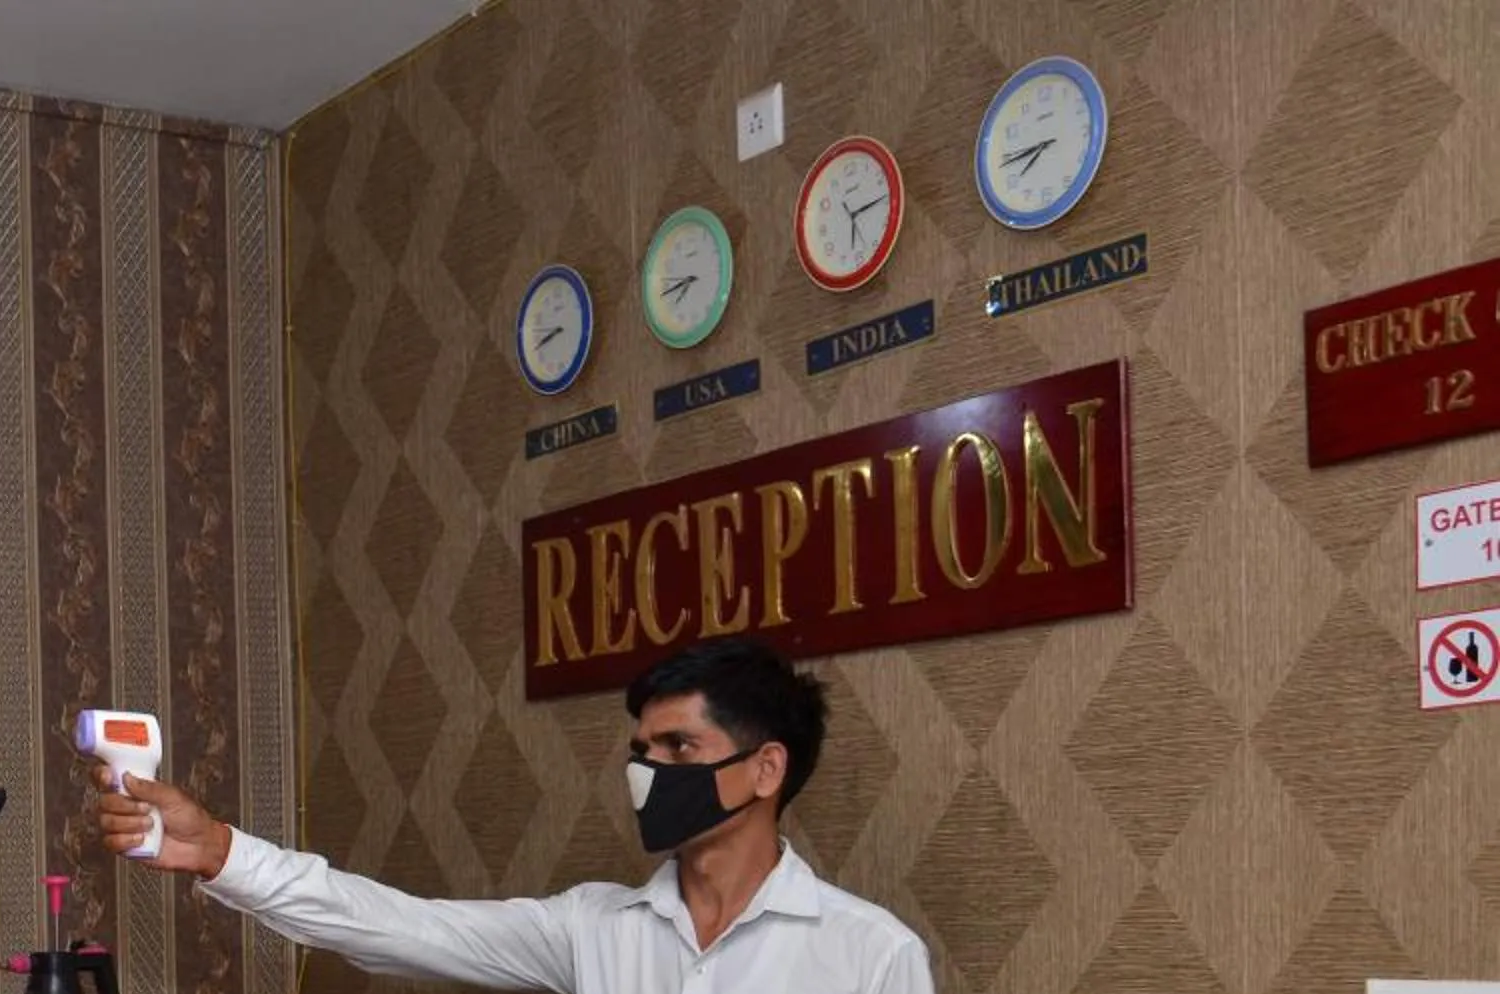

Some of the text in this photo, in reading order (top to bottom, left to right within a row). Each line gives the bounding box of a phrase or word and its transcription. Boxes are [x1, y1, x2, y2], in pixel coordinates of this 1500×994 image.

[997, 243, 1142, 309] THAILAND
[832, 319, 909, 364] INDIA
[1315, 291, 1477, 374] CHECK
[684, 375, 728, 408] USA
[1424, 369, 1476, 414] 12
[539, 415, 600, 451] CHINA
[532, 398, 1106, 666] RECEPTION
[1482, 538, 1500, 562] 1
